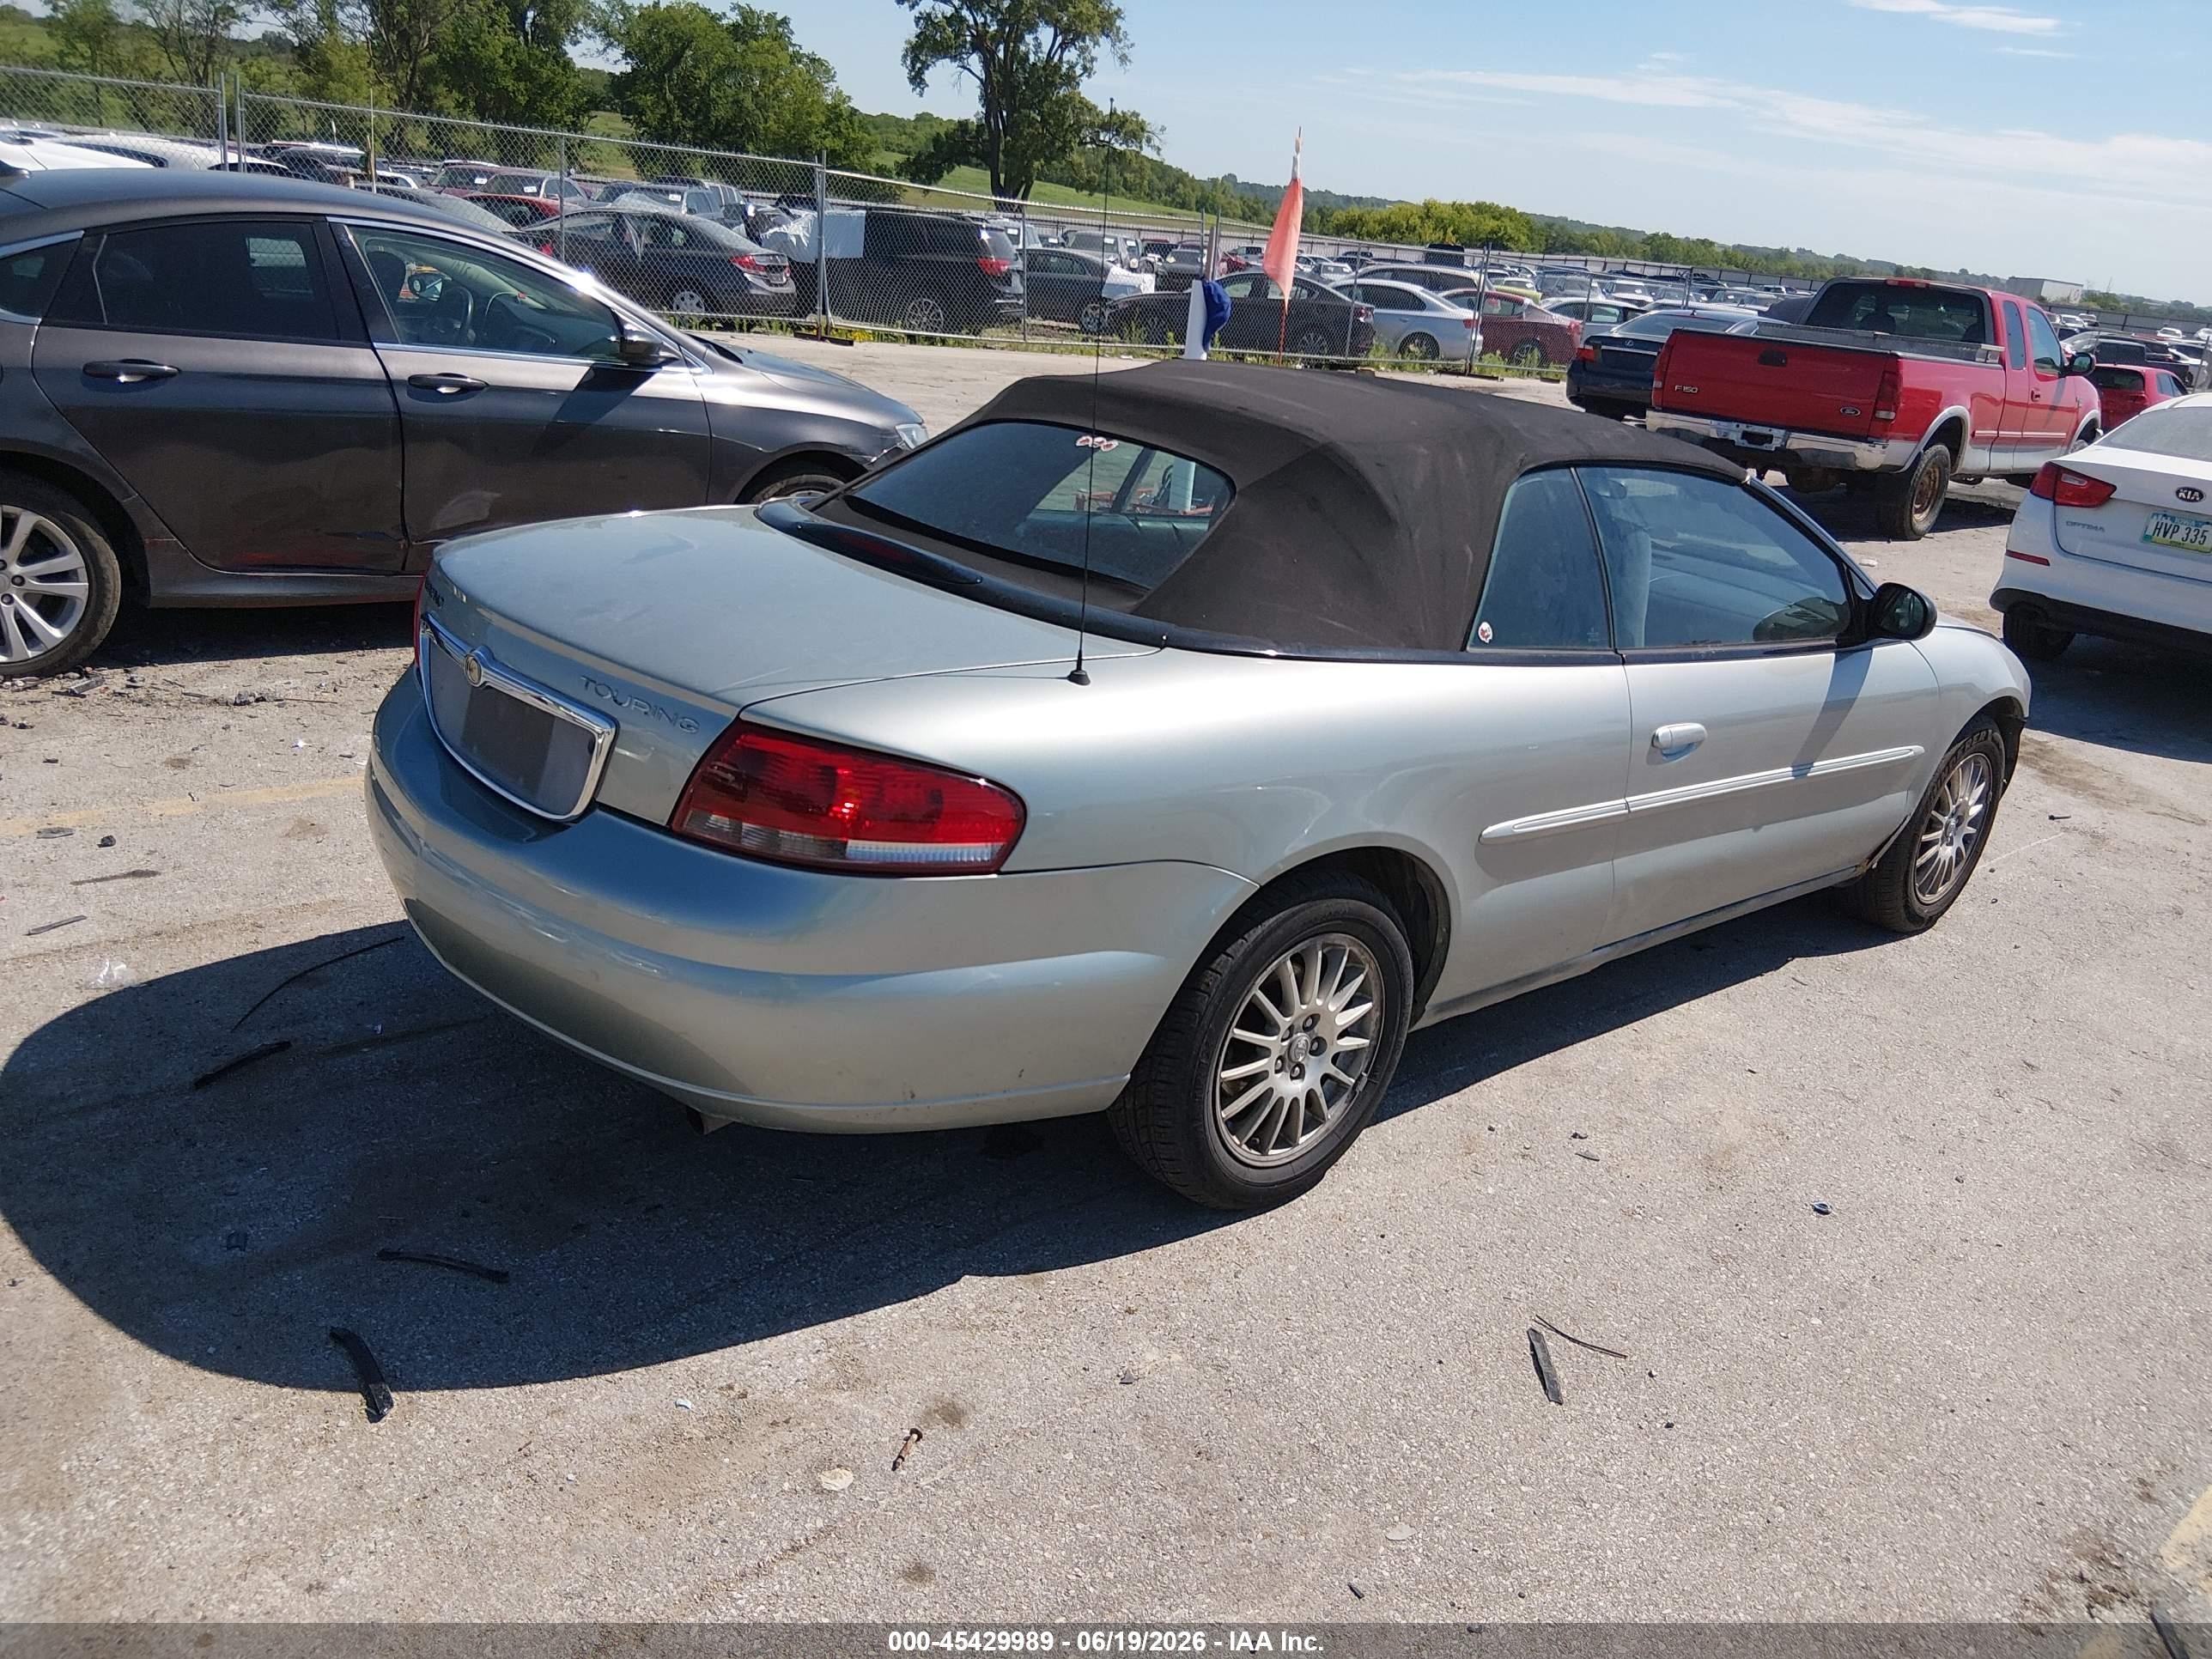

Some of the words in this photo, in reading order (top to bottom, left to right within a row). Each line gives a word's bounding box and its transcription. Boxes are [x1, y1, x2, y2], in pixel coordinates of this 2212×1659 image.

[2178, 489, 2201, 501] KIA
[2152, 520, 2179, 539] HVP
[2181, 526, 2209, 545] 335
[580, 675, 701, 735] TOURING
